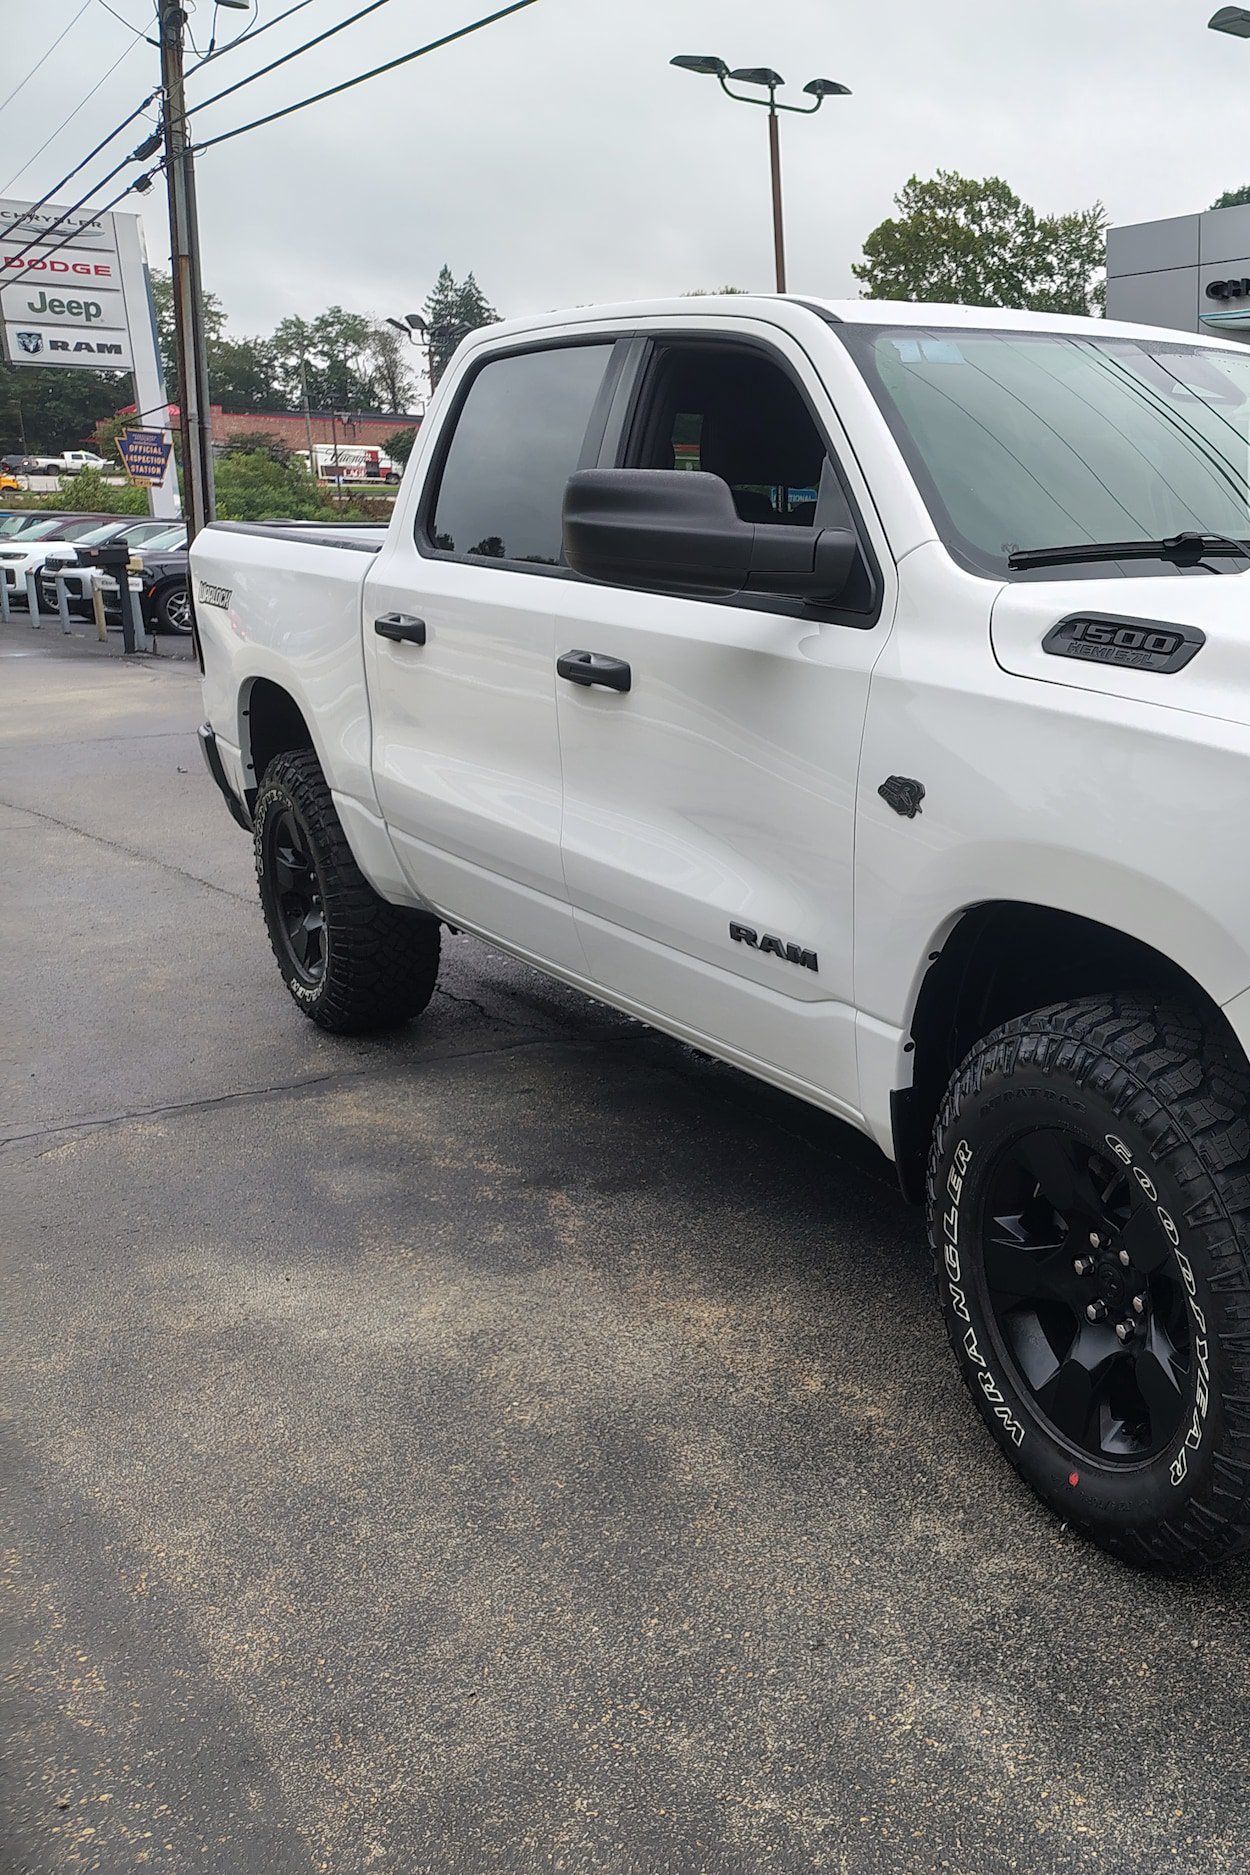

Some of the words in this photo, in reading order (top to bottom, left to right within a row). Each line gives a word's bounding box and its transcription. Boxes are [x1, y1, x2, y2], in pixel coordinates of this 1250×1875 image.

[1, 211, 102, 229] CHRYSLER
[4, 256, 112, 277] DODGE
[27, 291, 102, 322] Jeep
[49, 339, 122, 355] RAM
[129, 444, 162, 455] OFFICIAL
[125, 454, 166, 465] INSPECTION
[130, 464, 161, 475] STATION
[1070, 622, 1179, 655] 1500
[1067, 642, 1116, 659] HEMI
[729, 920, 819, 972] RAM
[943, 1139, 1026, 1447] WRANGLER
[1104, 1133, 1210, 1487] GOODYEAR
